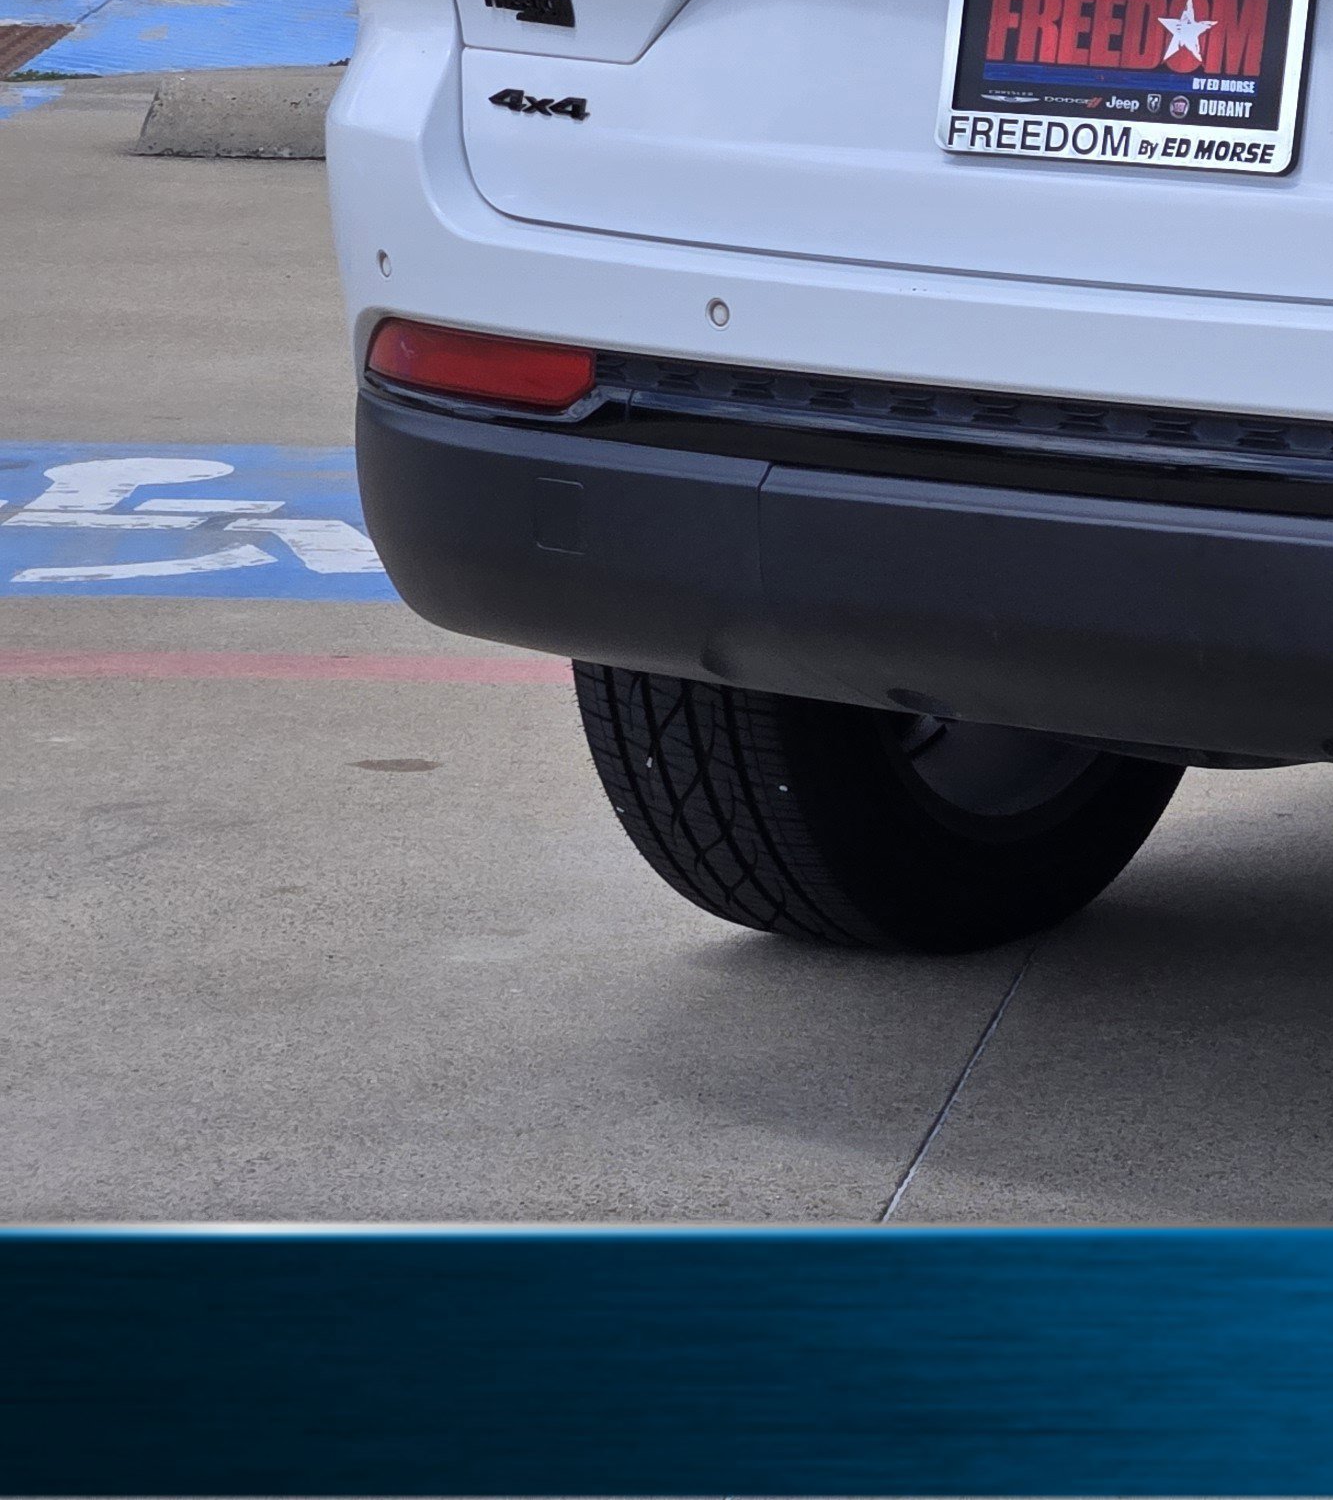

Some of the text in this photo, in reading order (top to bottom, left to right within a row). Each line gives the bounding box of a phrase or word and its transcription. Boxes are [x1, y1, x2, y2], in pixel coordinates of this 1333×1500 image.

[1192, 77, 1256, 94] BY ED MORSE
[488, 88, 591, 122] 4x4
[1105, 95, 1140, 113] Jeep
[1198, 98, 1253, 119] DURANT
[947, 115, 1133, 158] FREEDOM
[1160, 136, 1192, 159] ED
[1193, 139, 1277, 165] MORSE
